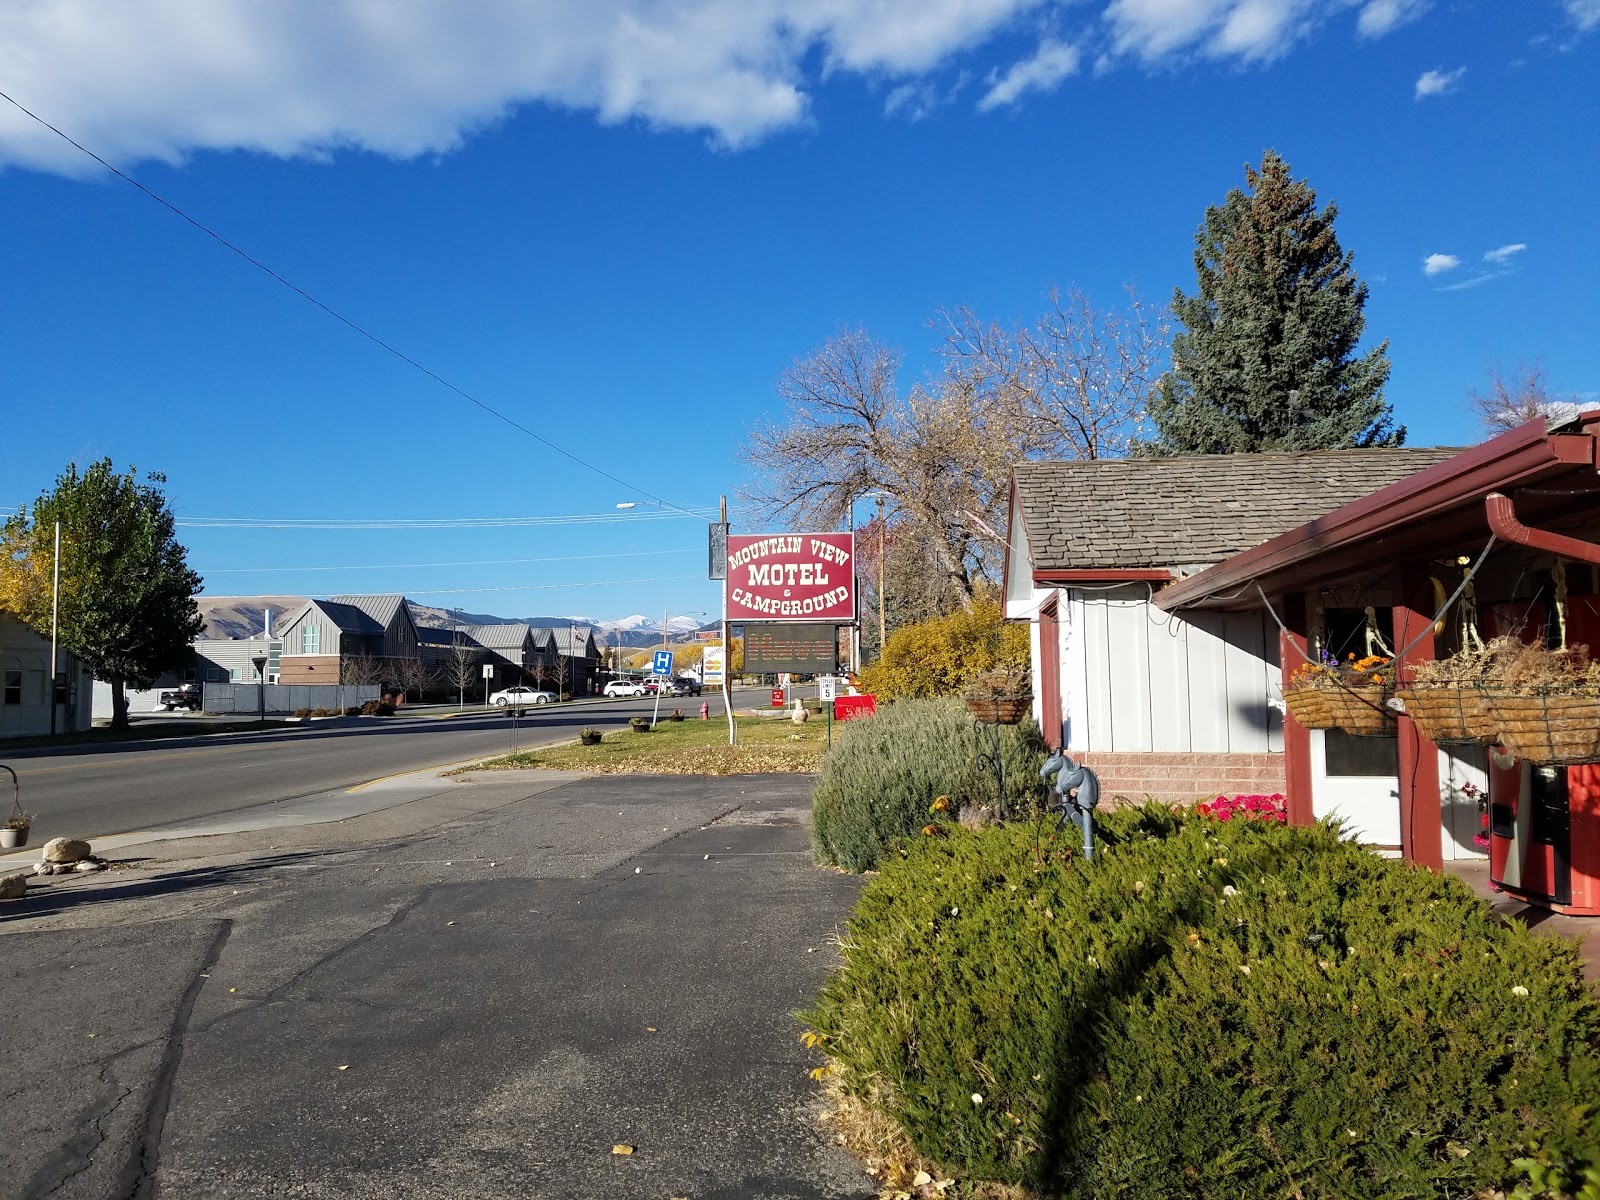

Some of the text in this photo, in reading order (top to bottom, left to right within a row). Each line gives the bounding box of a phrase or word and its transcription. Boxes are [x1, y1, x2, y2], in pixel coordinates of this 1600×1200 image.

[728, 537, 802, 570] MOUNTAIN
[811, 539, 850, 566] VIEW
[748, 563, 829, 586] MOTEL
[731, 586, 849, 615] CAMPGROUND
[783, 588, 792, 597] &
[656, 652, 670, 667] H
[825, 689, 831, 698] 5
